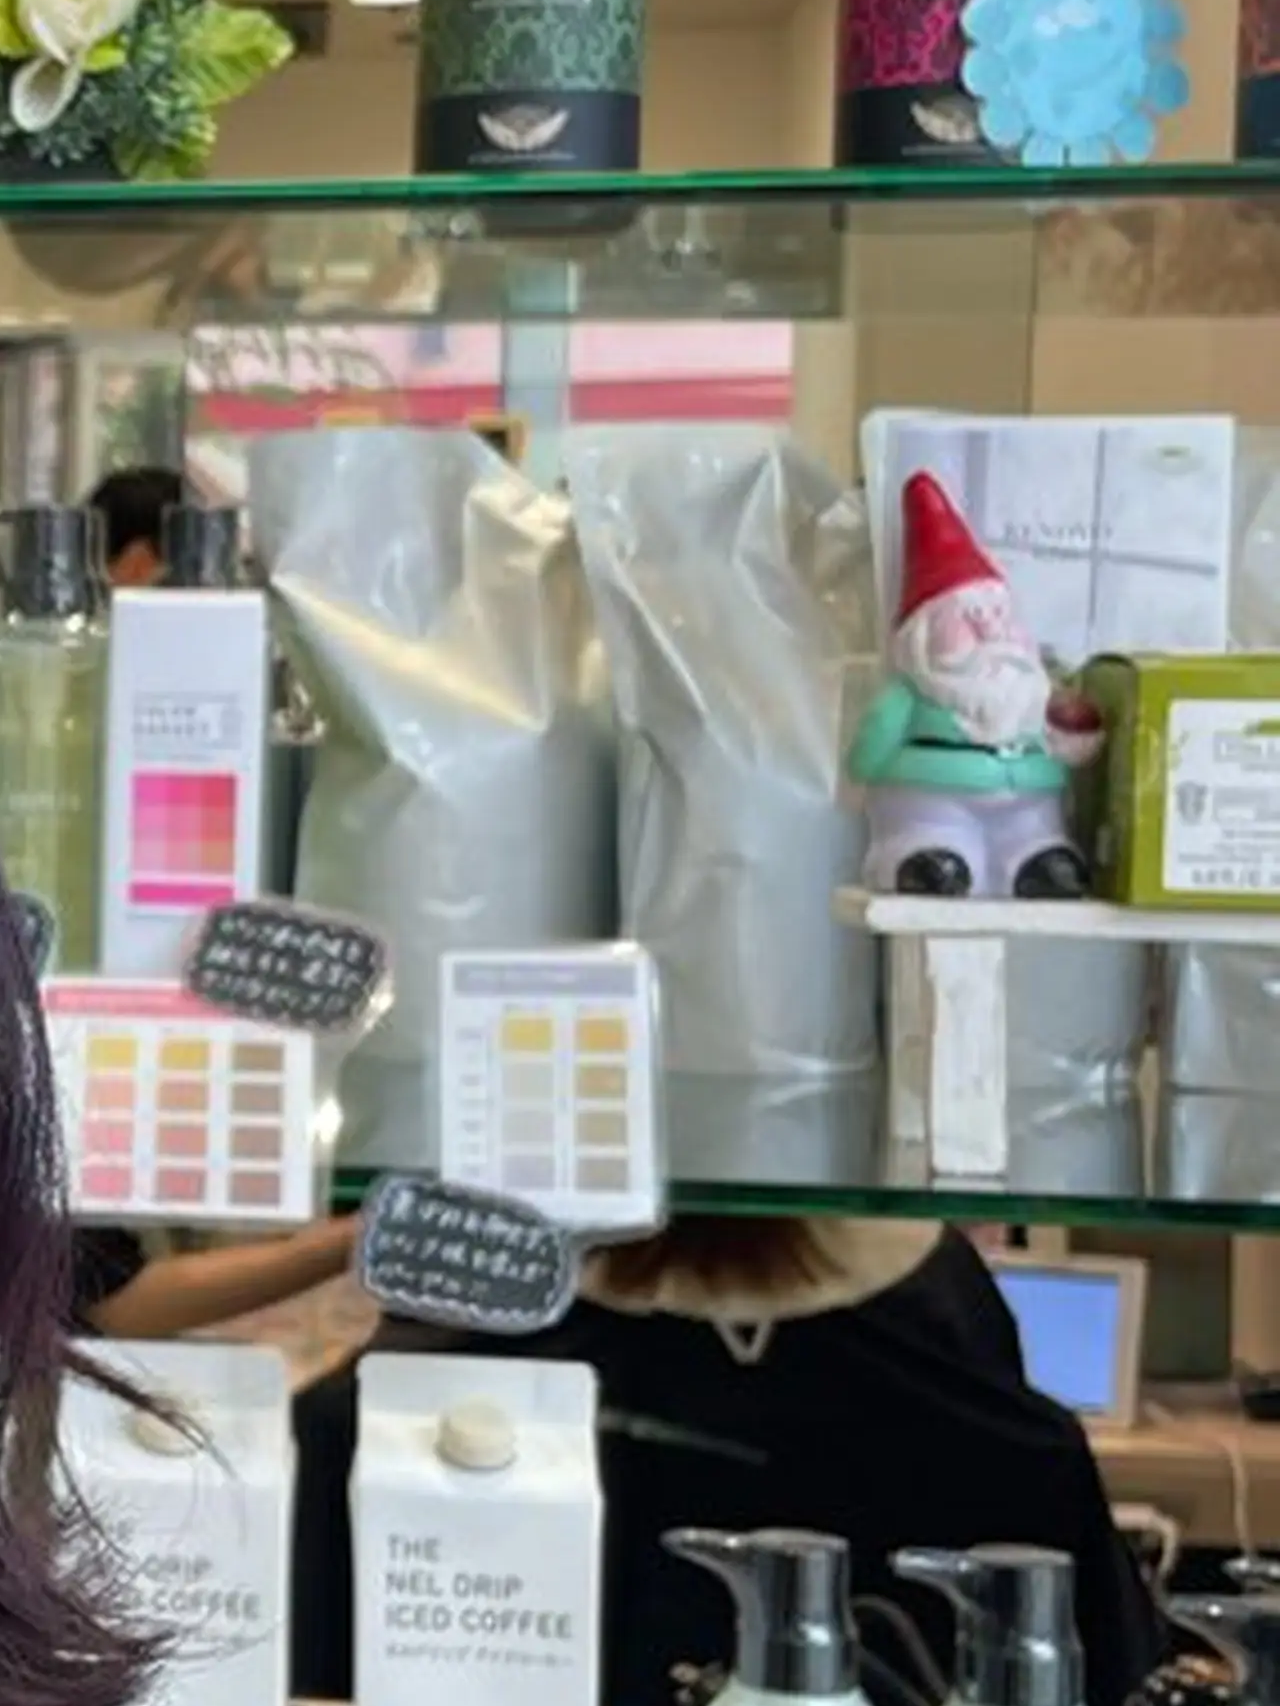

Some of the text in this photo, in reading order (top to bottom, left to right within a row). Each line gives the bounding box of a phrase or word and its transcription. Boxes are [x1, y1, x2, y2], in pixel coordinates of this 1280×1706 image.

[387, 1533, 441, 1563] THE
[385, 1568, 526, 1601] NEL DRIP
[385, 1603, 573, 1640] ICED COFFEE
